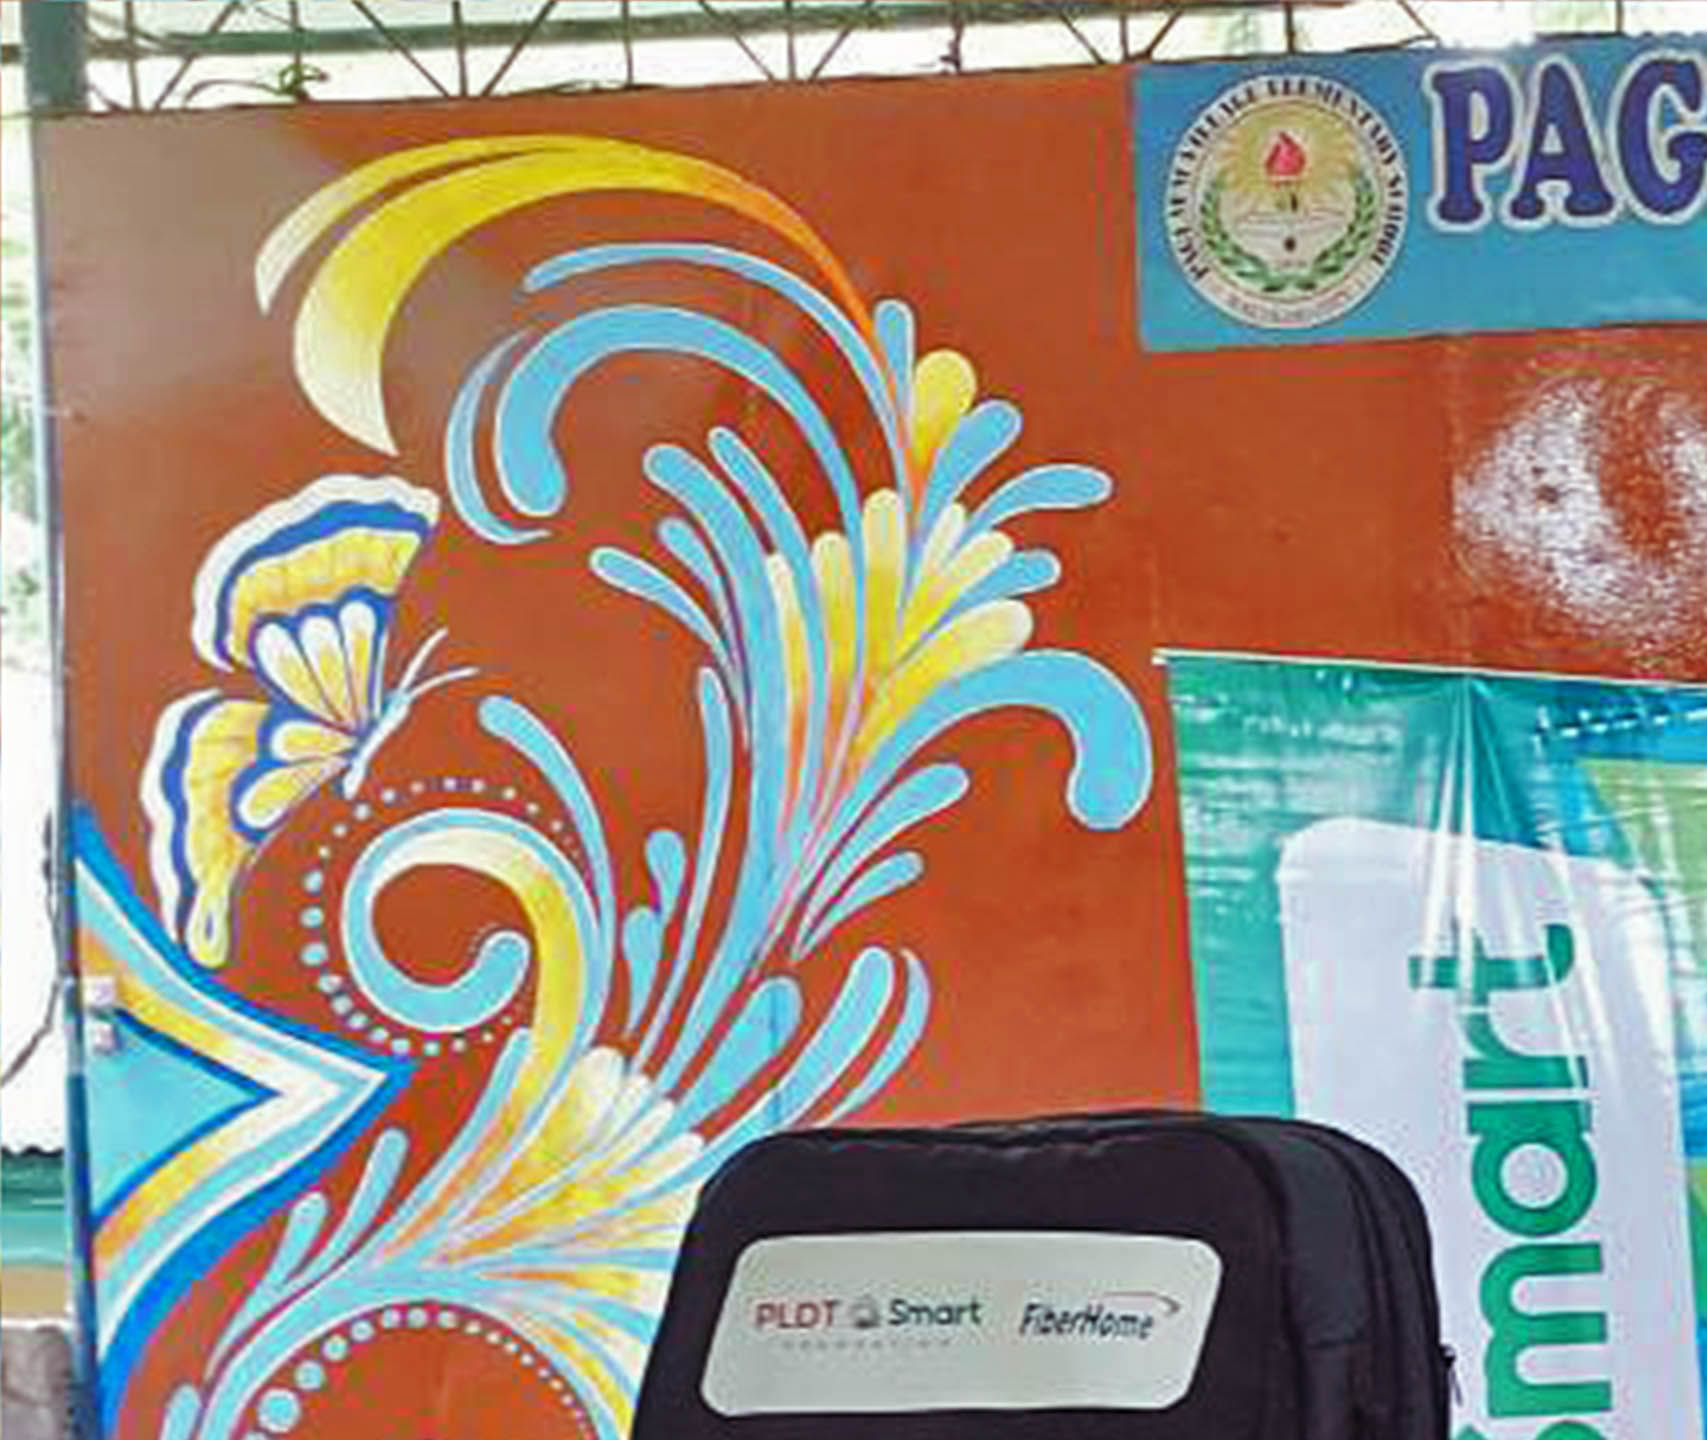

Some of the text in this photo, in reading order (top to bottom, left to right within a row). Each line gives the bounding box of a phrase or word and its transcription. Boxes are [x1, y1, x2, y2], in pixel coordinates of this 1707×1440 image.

[756, 1296, 1154, 1339] PLDT Smart FiberHome
